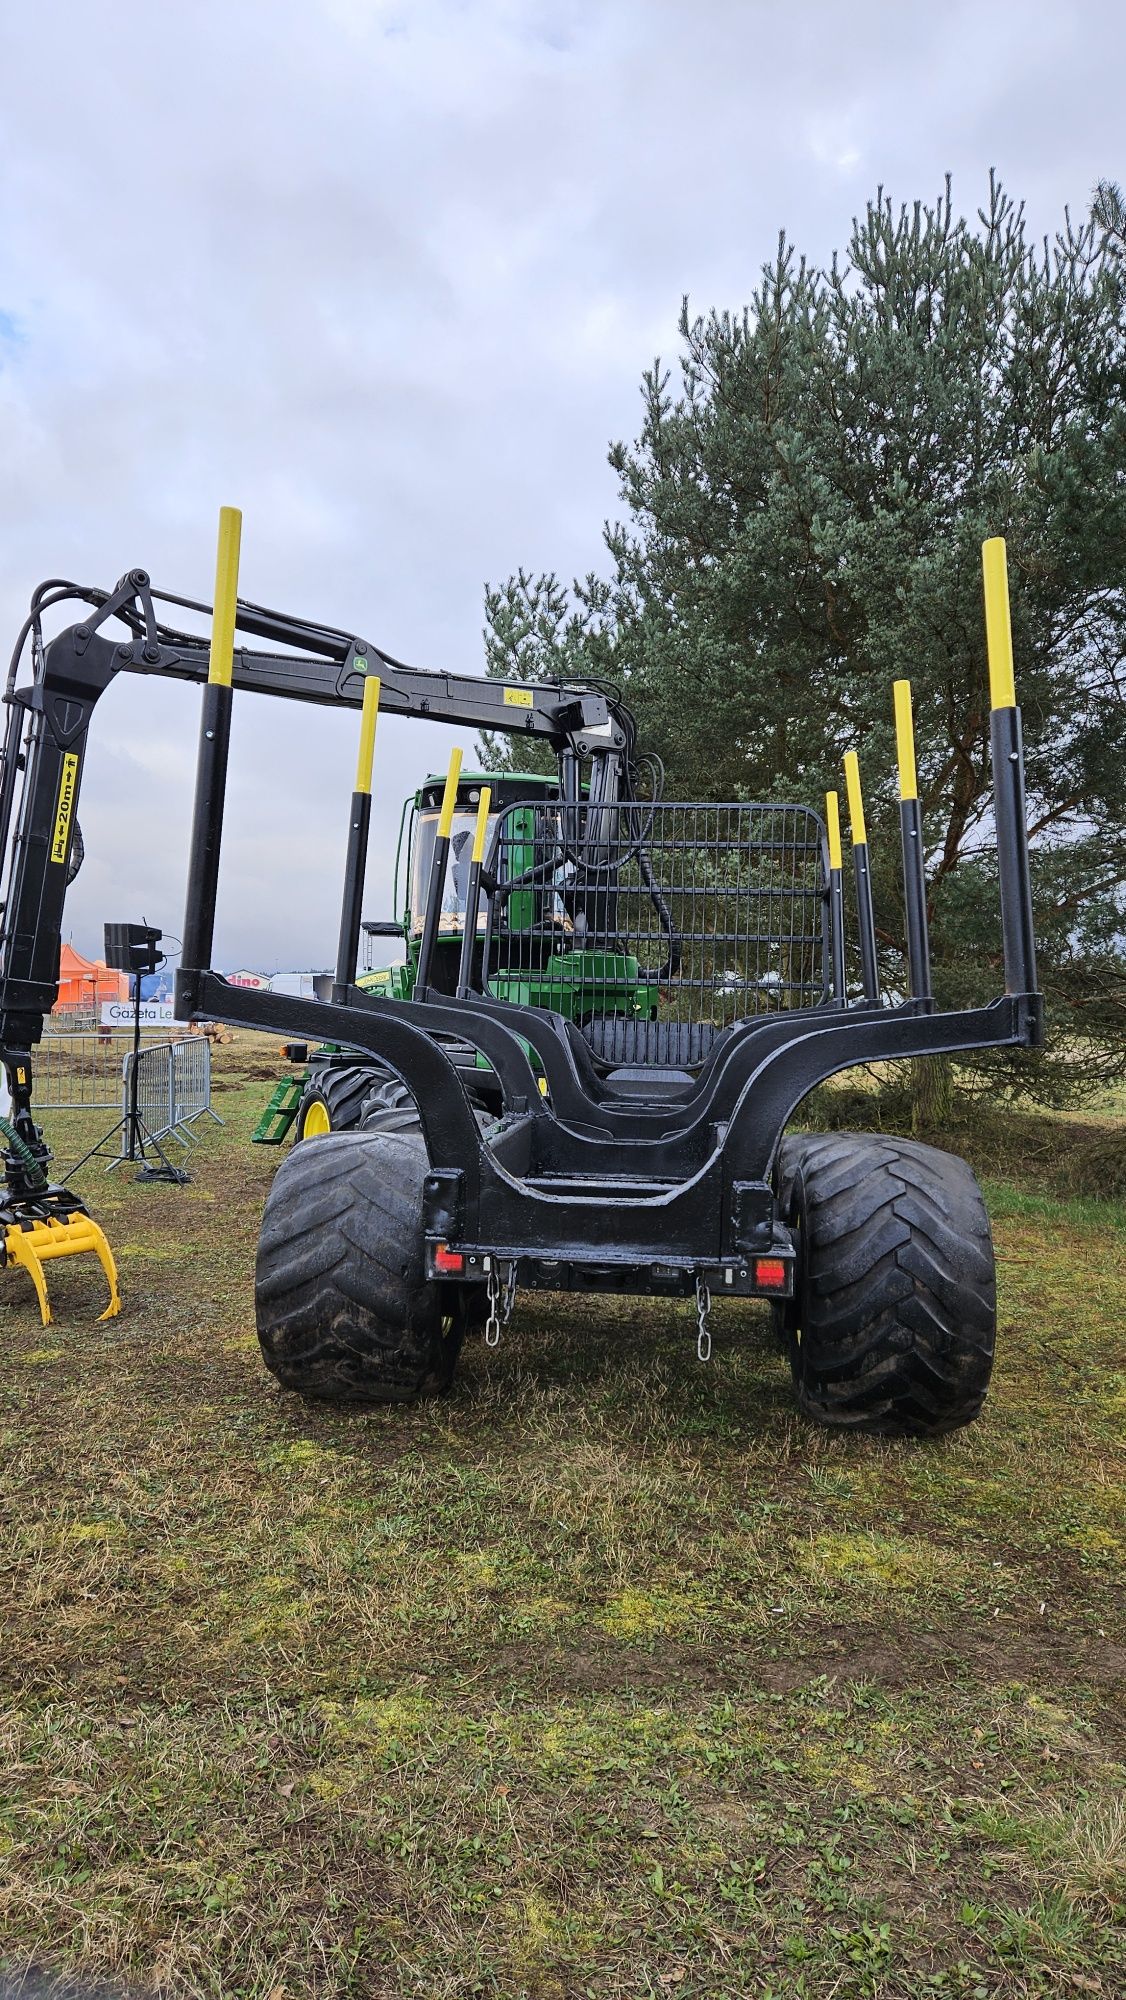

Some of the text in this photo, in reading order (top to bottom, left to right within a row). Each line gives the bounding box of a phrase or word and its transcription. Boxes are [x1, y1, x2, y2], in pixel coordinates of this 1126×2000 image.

[58, 784, 72, 823] 20m
[109, 1005, 156, 1019] Gazeta
[159, 1006, 173, 1019] Le
